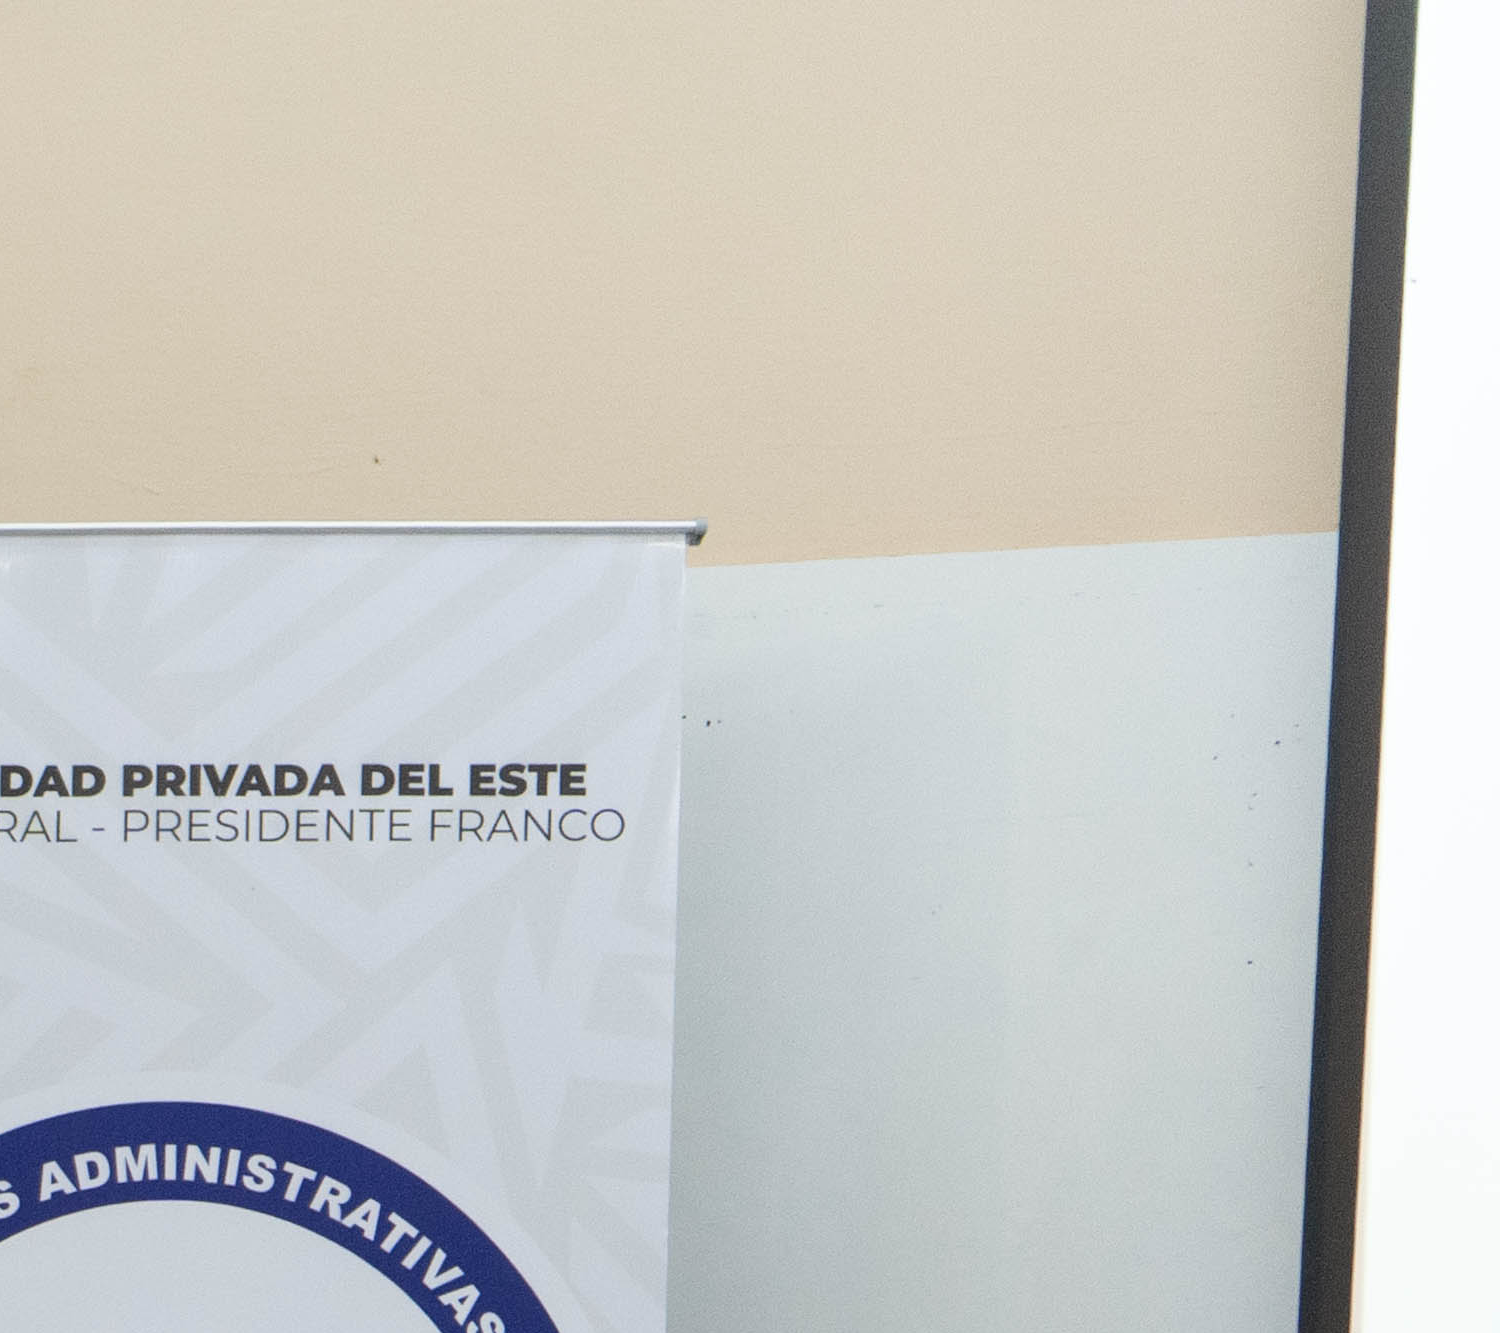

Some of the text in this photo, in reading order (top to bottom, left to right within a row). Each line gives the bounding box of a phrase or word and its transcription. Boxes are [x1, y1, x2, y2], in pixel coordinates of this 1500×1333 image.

[123, 764, 345, 796] PRIVADA
[361, 764, 453, 796] DEL
[470, 764, 586, 796] ESTE
[124, 809, 412, 842] PRESIDENTE
[430, 809, 625, 842] FRANCO
